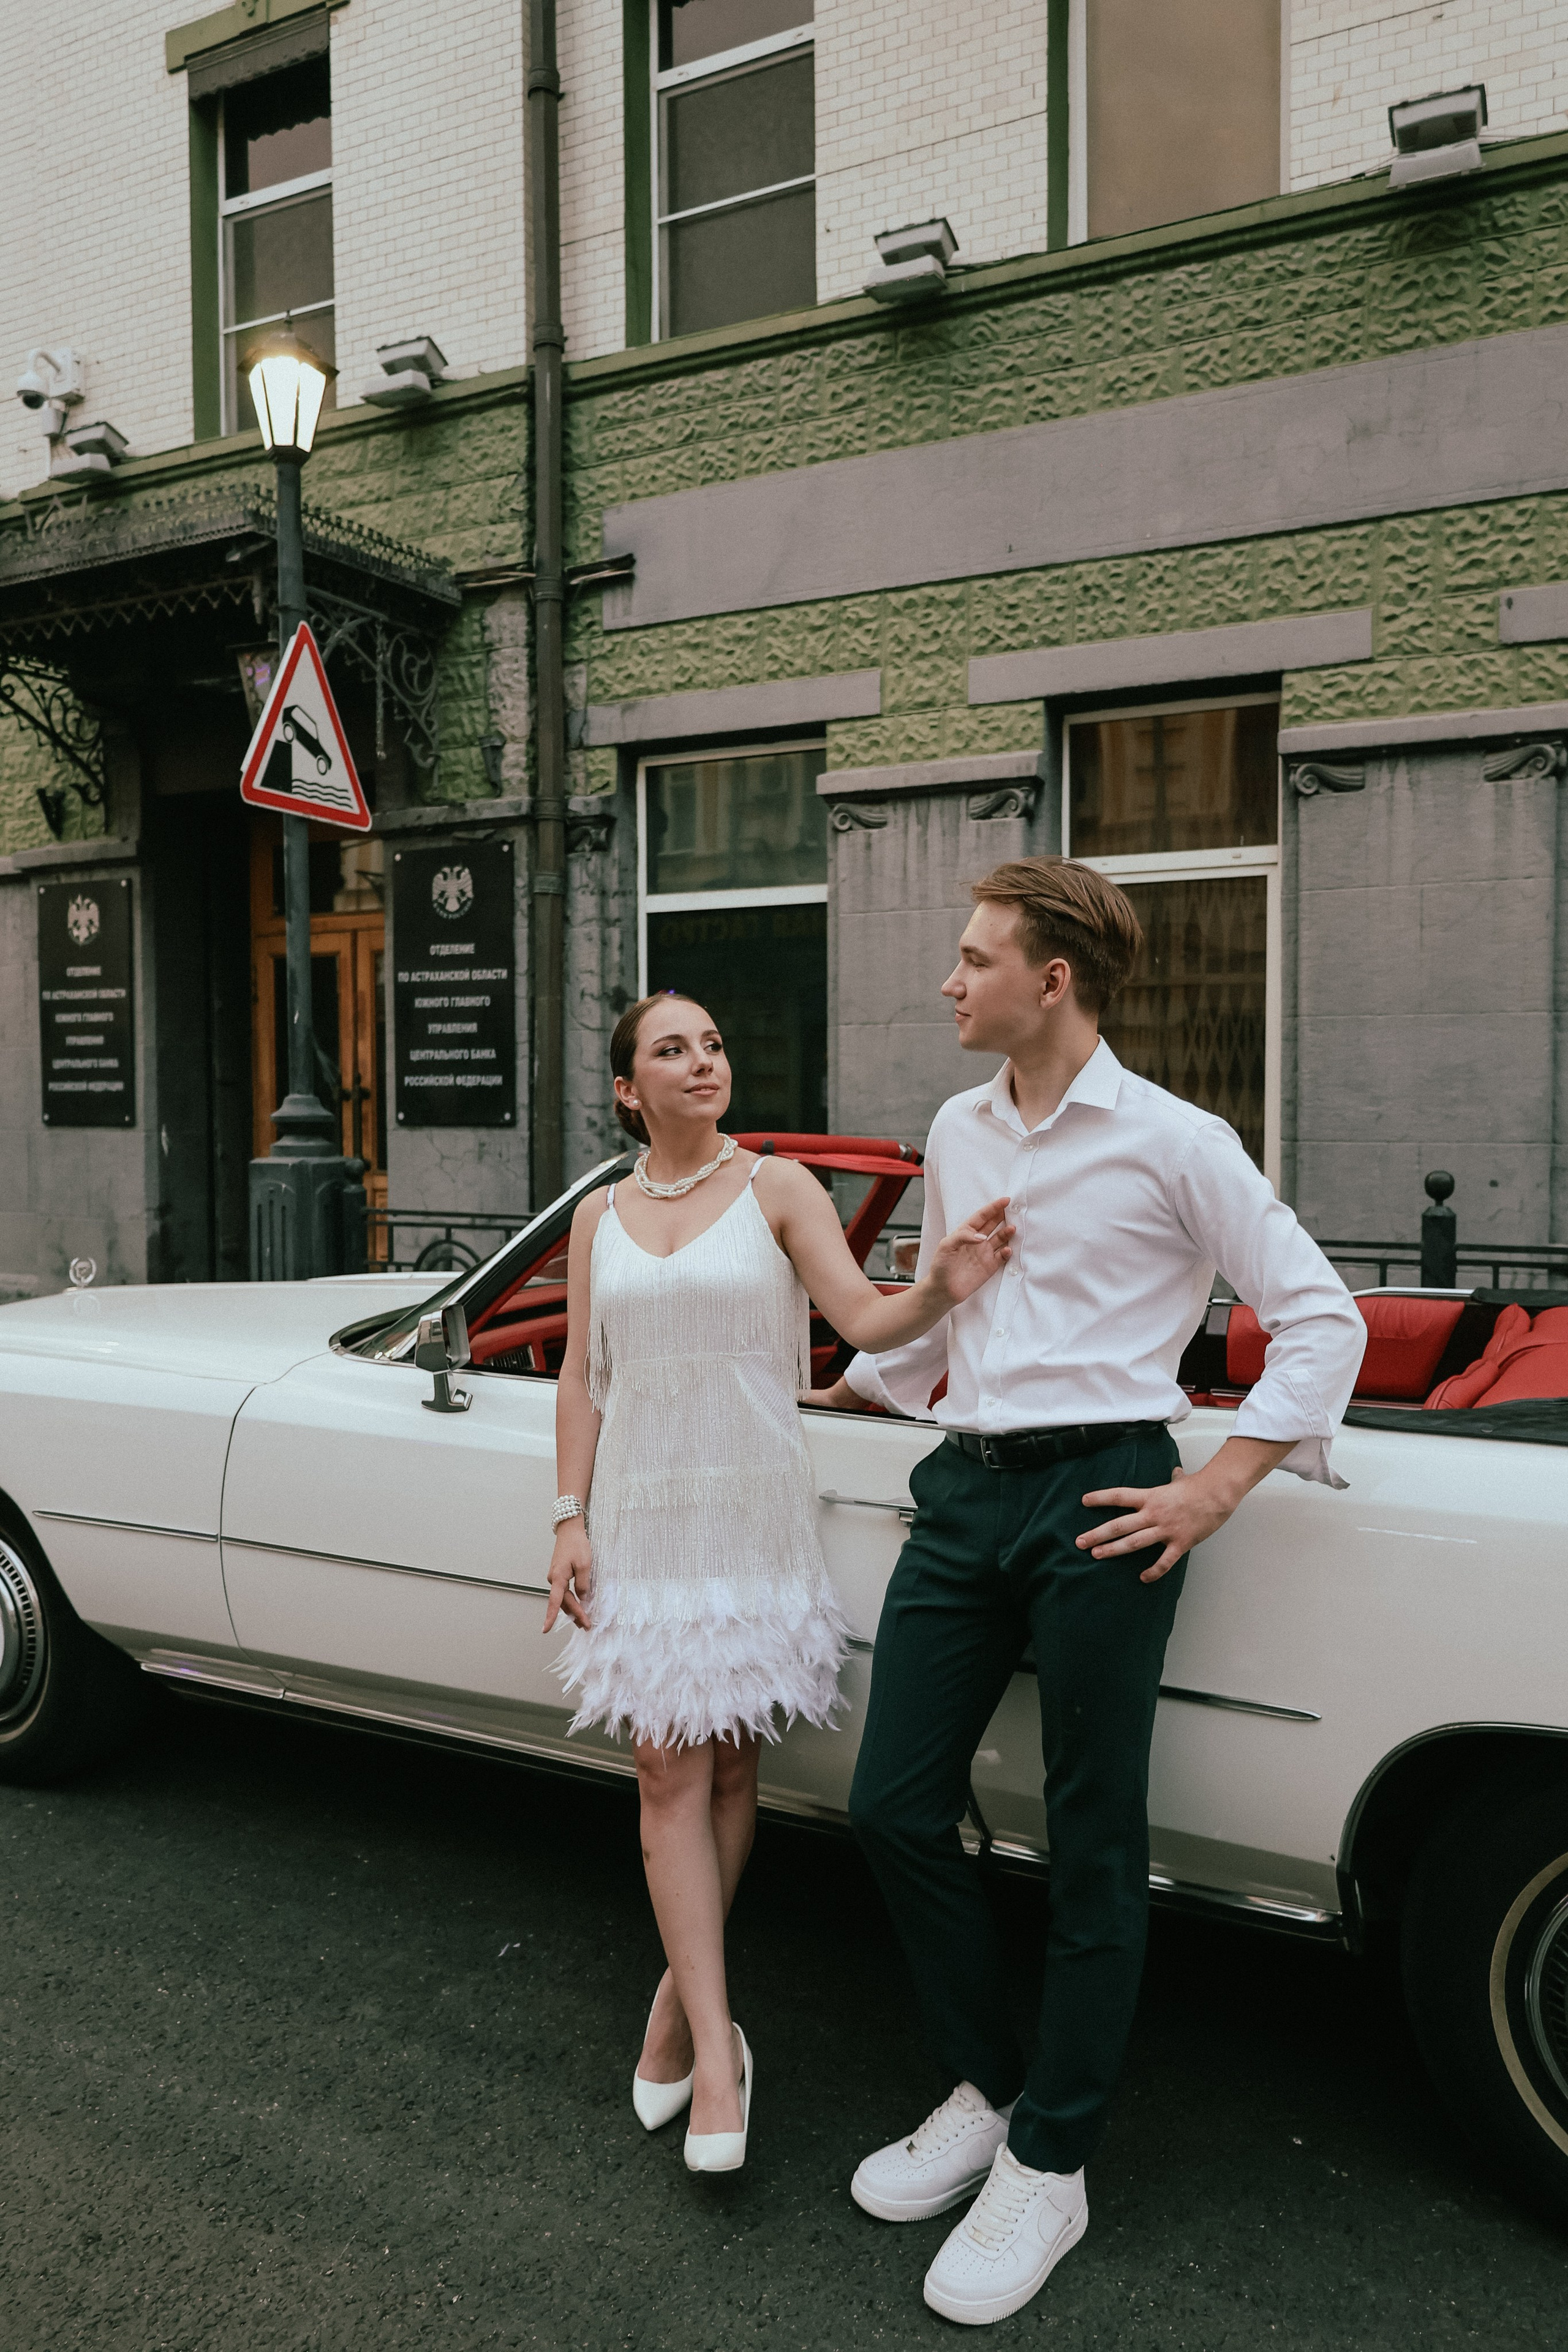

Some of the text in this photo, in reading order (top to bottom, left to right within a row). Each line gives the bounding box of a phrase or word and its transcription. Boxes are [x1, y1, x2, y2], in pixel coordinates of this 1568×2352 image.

[431, 944, 475, 956] ОТДЕЛЕНИЕ
[398, 969, 508, 982] ПО АСТРАХАНСКОЙ ОБЛАСТИ
[415, 997, 491, 1008] ЮЖНОГО ГЛАВНОГО
[429, 1023, 478, 1035] УПРАВЛЕНИЯ
[410, 1050, 496, 1061] ЦЕНТРАЛЬНОГО БАНКА
[405, 1075, 503, 1087] РОССИЙСКОЙ ФЕДЕРАЦИИ
